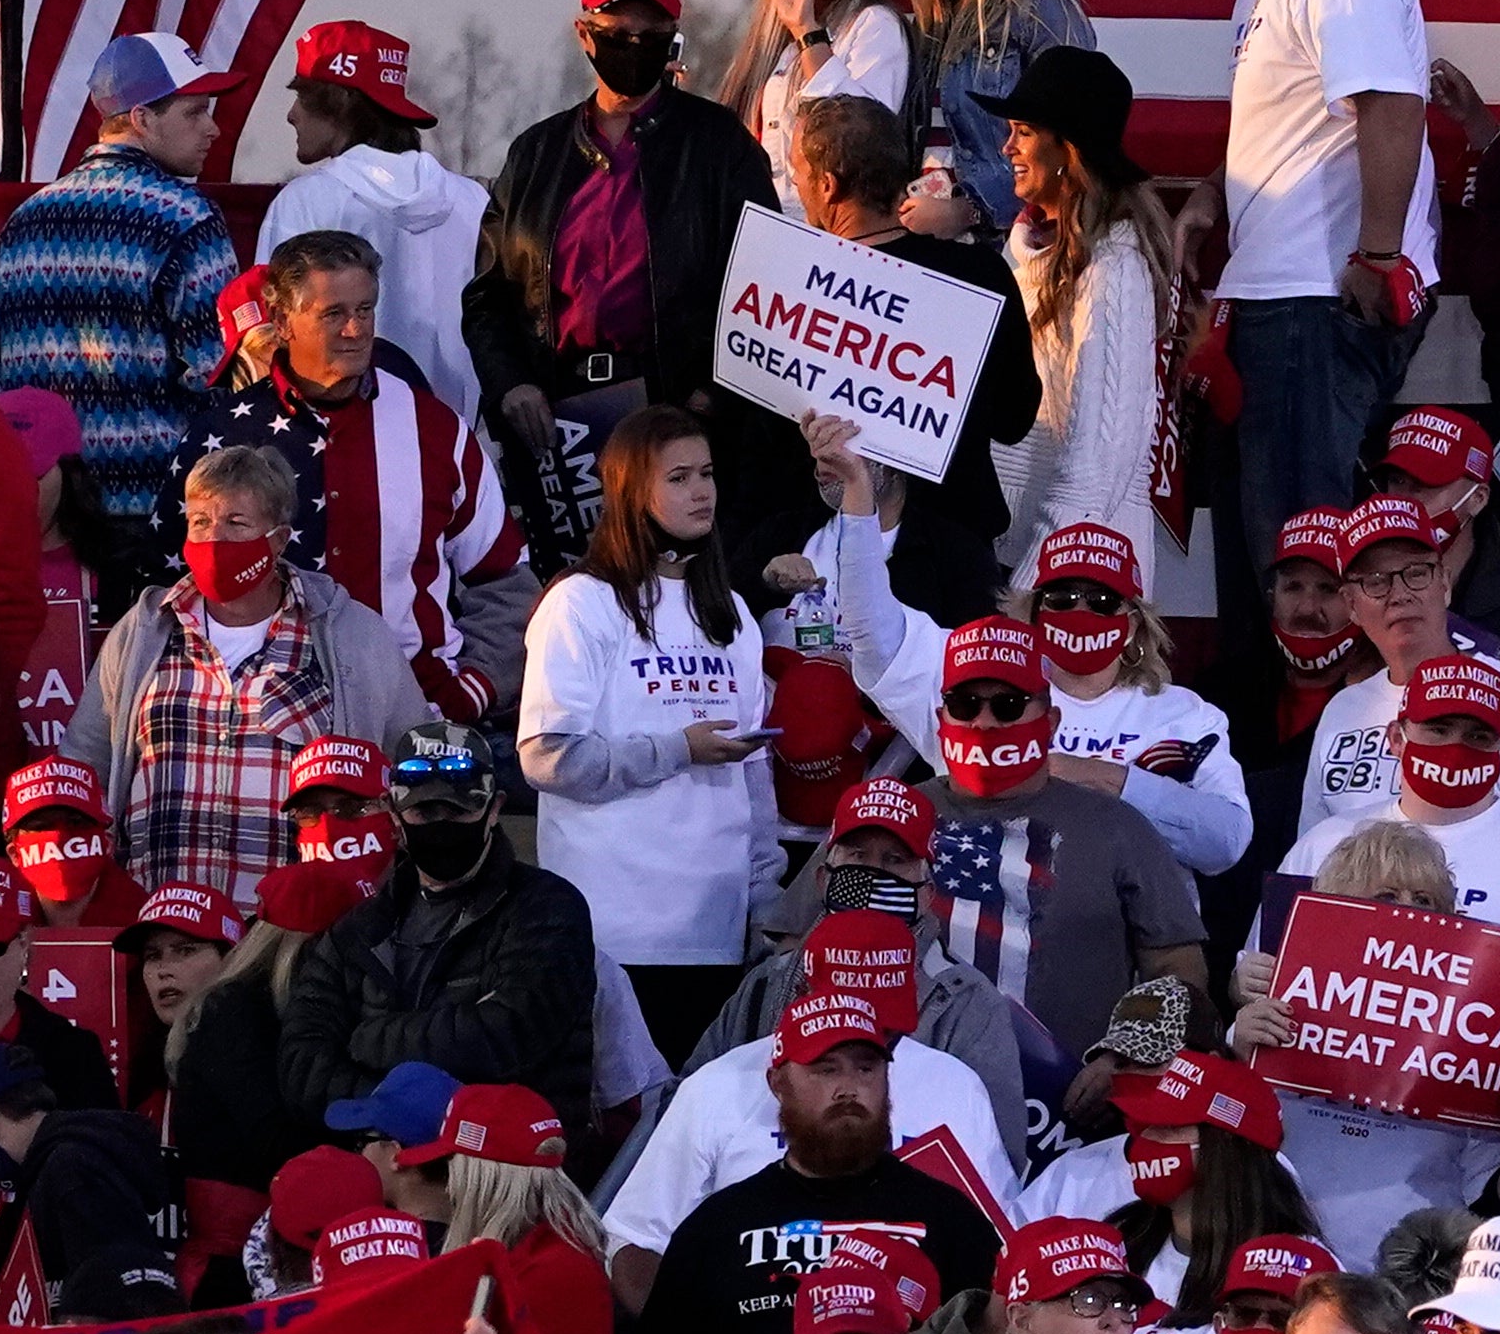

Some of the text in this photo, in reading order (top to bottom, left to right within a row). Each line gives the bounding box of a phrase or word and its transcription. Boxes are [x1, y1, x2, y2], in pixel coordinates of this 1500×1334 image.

[329, 53, 358, 77] 45
[805, 266, 910, 323] MAKE
[732, 282, 958, 398] AMERICA
[728, 332, 949, 438] GREAT AGAIN
[949, 628, 1034, 651] MAKE AMERICA
[1044, 622, 1121, 653] TRUMP
[955, 647, 1027, 666] GREAT AGAIN
[647, 677, 738, 694] PENCE
[946, 736, 1041, 766] MAGA
[1410, 757, 1496, 786] TRUMP
[867, 779, 909, 796] KEEP
[850, 793, 919, 817] AMERICA
[857, 805, 909, 824] GREAT
[20, 835, 104, 867] MAGA
[301, 832, 382, 863] MAGA
[1362, 936, 1474, 987] MAKE
[1341, 1126, 1370, 1138] 2020
[739, 1224, 834, 1267] Tru
[808, 1284, 876, 1305] Trump
[1008, 1269, 1029, 1300] 45
[739, 1293, 782, 1315] KEEP
[827, 1298, 859, 1307] 2020
